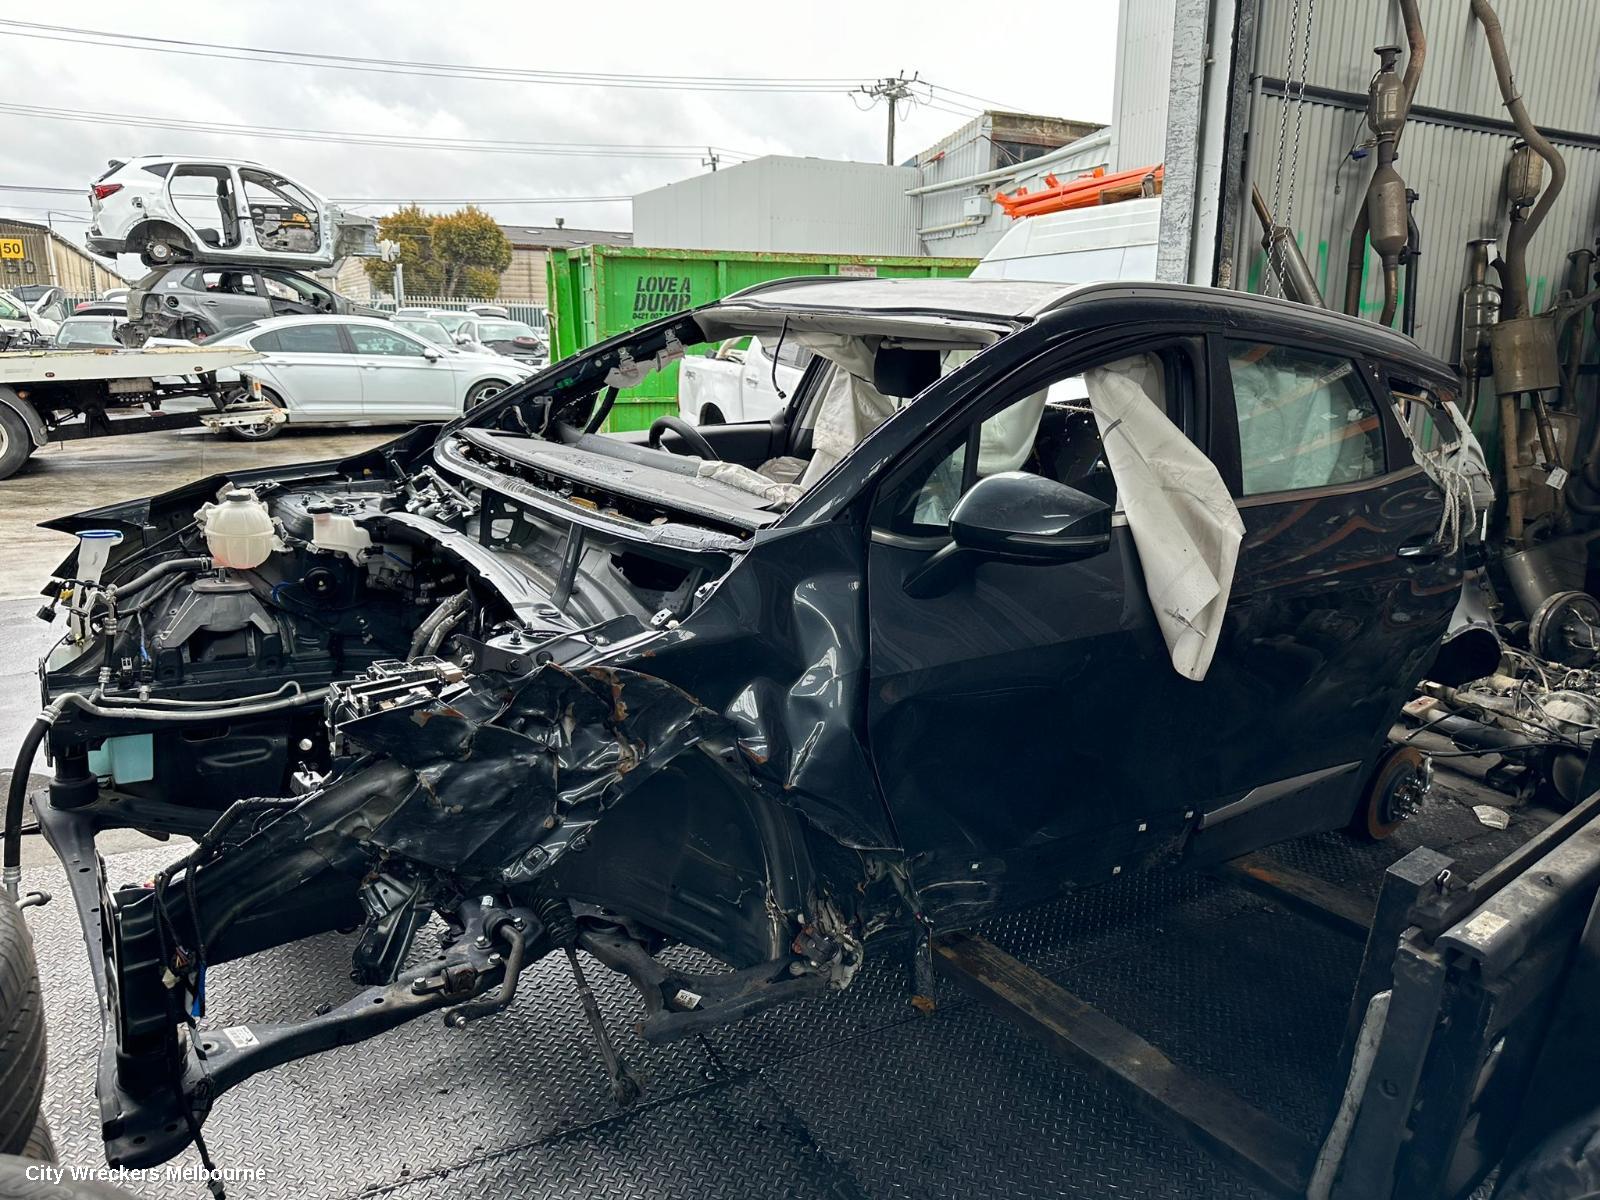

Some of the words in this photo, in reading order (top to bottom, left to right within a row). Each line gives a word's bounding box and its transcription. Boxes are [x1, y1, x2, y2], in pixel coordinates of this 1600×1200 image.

[3, 242, 21, 255] 50
[636, 276, 677, 292] LOVE
[680, 277, 691, 292] A
[633, 293, 691, 312] DUMP
